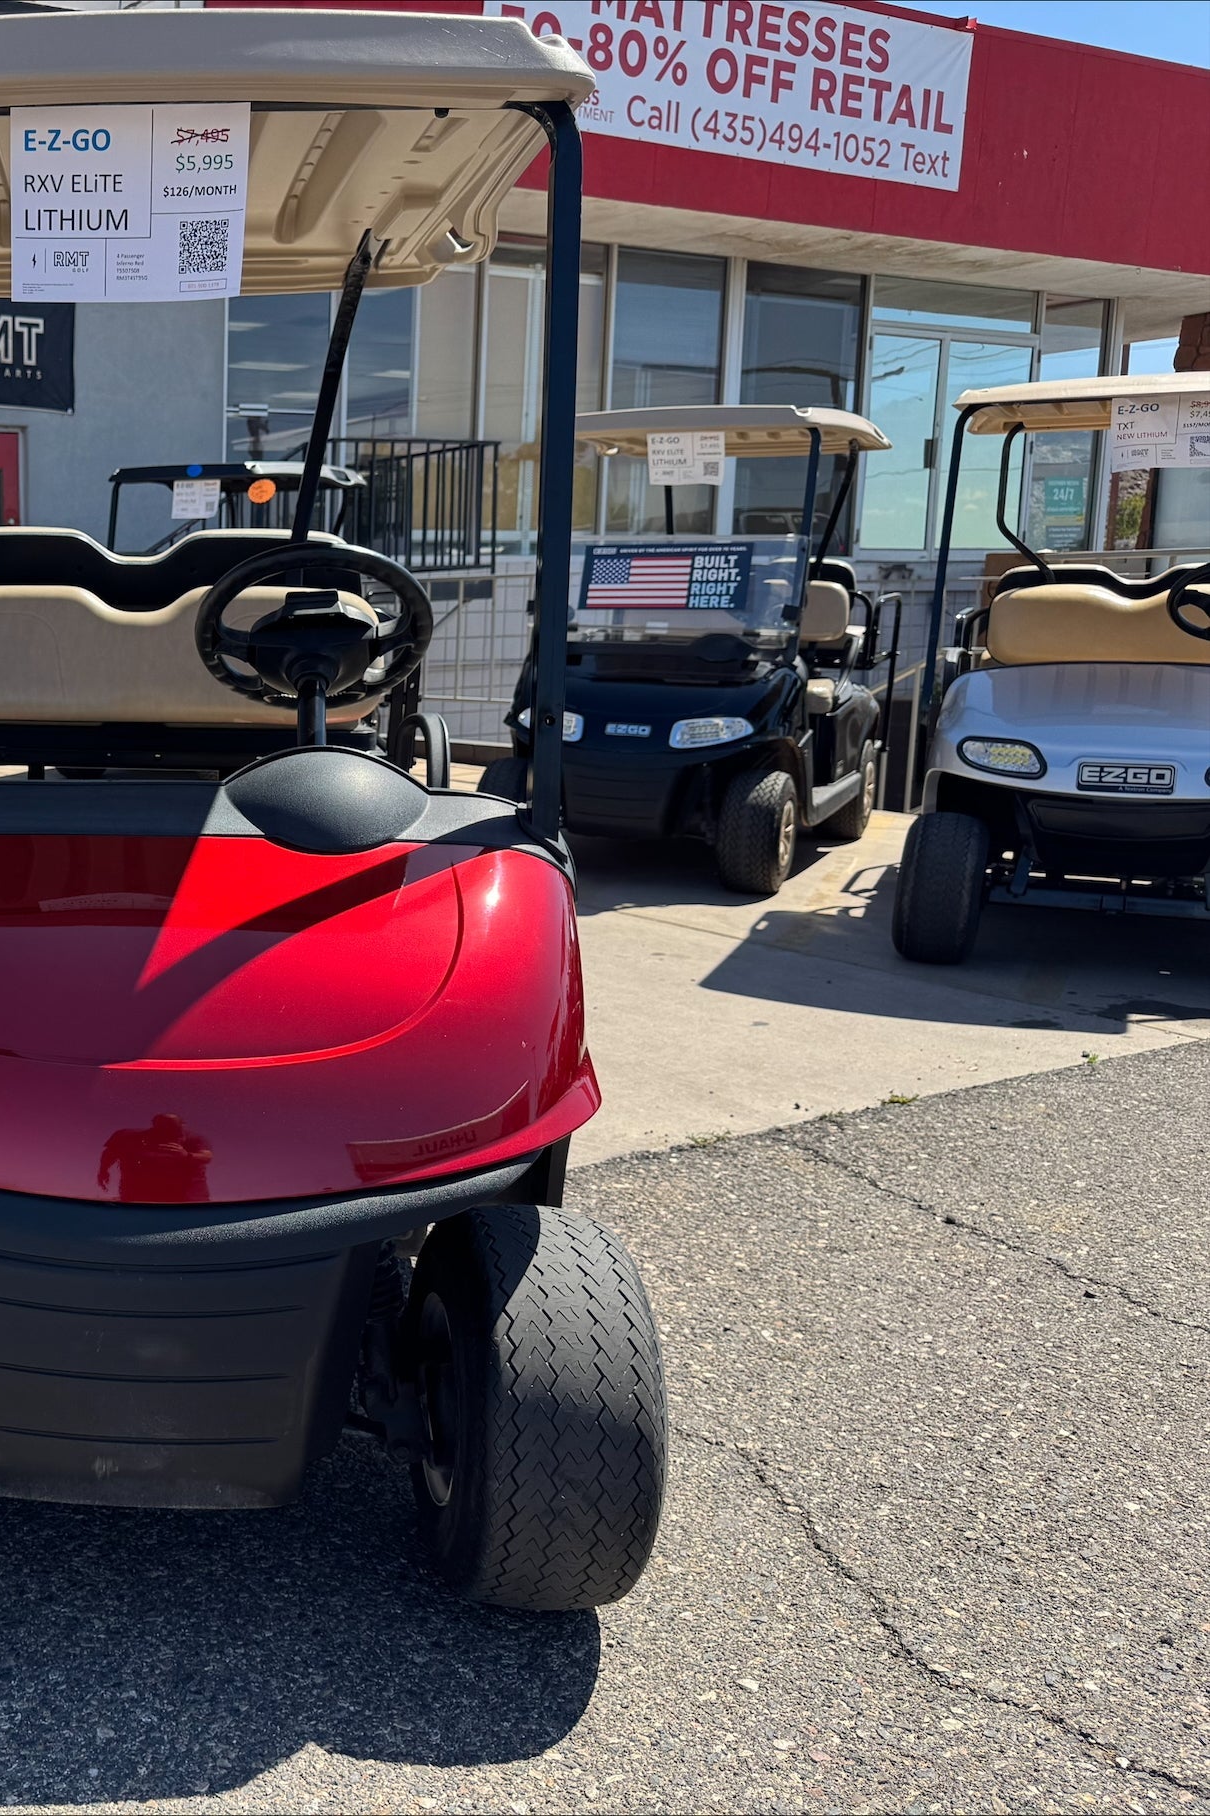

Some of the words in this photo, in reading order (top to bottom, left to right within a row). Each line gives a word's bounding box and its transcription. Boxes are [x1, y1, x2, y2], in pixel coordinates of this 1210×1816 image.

[705, 48, 796, 104] OFF
[810, 67, 954, 135] RETAIL
[24, 129, 111, 151] E-Z-GO
[626, 95, 680, 134] Call
[690, 106, 891, 169] (435)494-1052
[900, 142, 950, 179] Text
[175, 153, 234, 174] $5,995
[24, 174, 64, 193] RXV
[162, 184, 237, 198] $126/MONTH
[24, 208, 129, 231] LITHIUM
[53, 251, 89, 267] RMT
[1117, 403, 1160, 415] E-Z-GO
[1117, 421, 1135, 431] TXT
[651, 436, 680, 445] E-Z-GO
[1116, 432, 1135, 441] NEW
[1136, 431, 1168, 439] LITHIUM
[652, 458, 687, 466] LITHIUM
[1053, 488, 1074, 500] 24/7
[693, 555, 738, 568] BUILT
[691, 568, 741, 581] RIGHT.
[689, 582, 738, 595] RIGHT
[688, 596, 734, 608] HERE.
[605, 723, 651, 737] EZGO
[1081, 766, 1172, 785] EZGO
